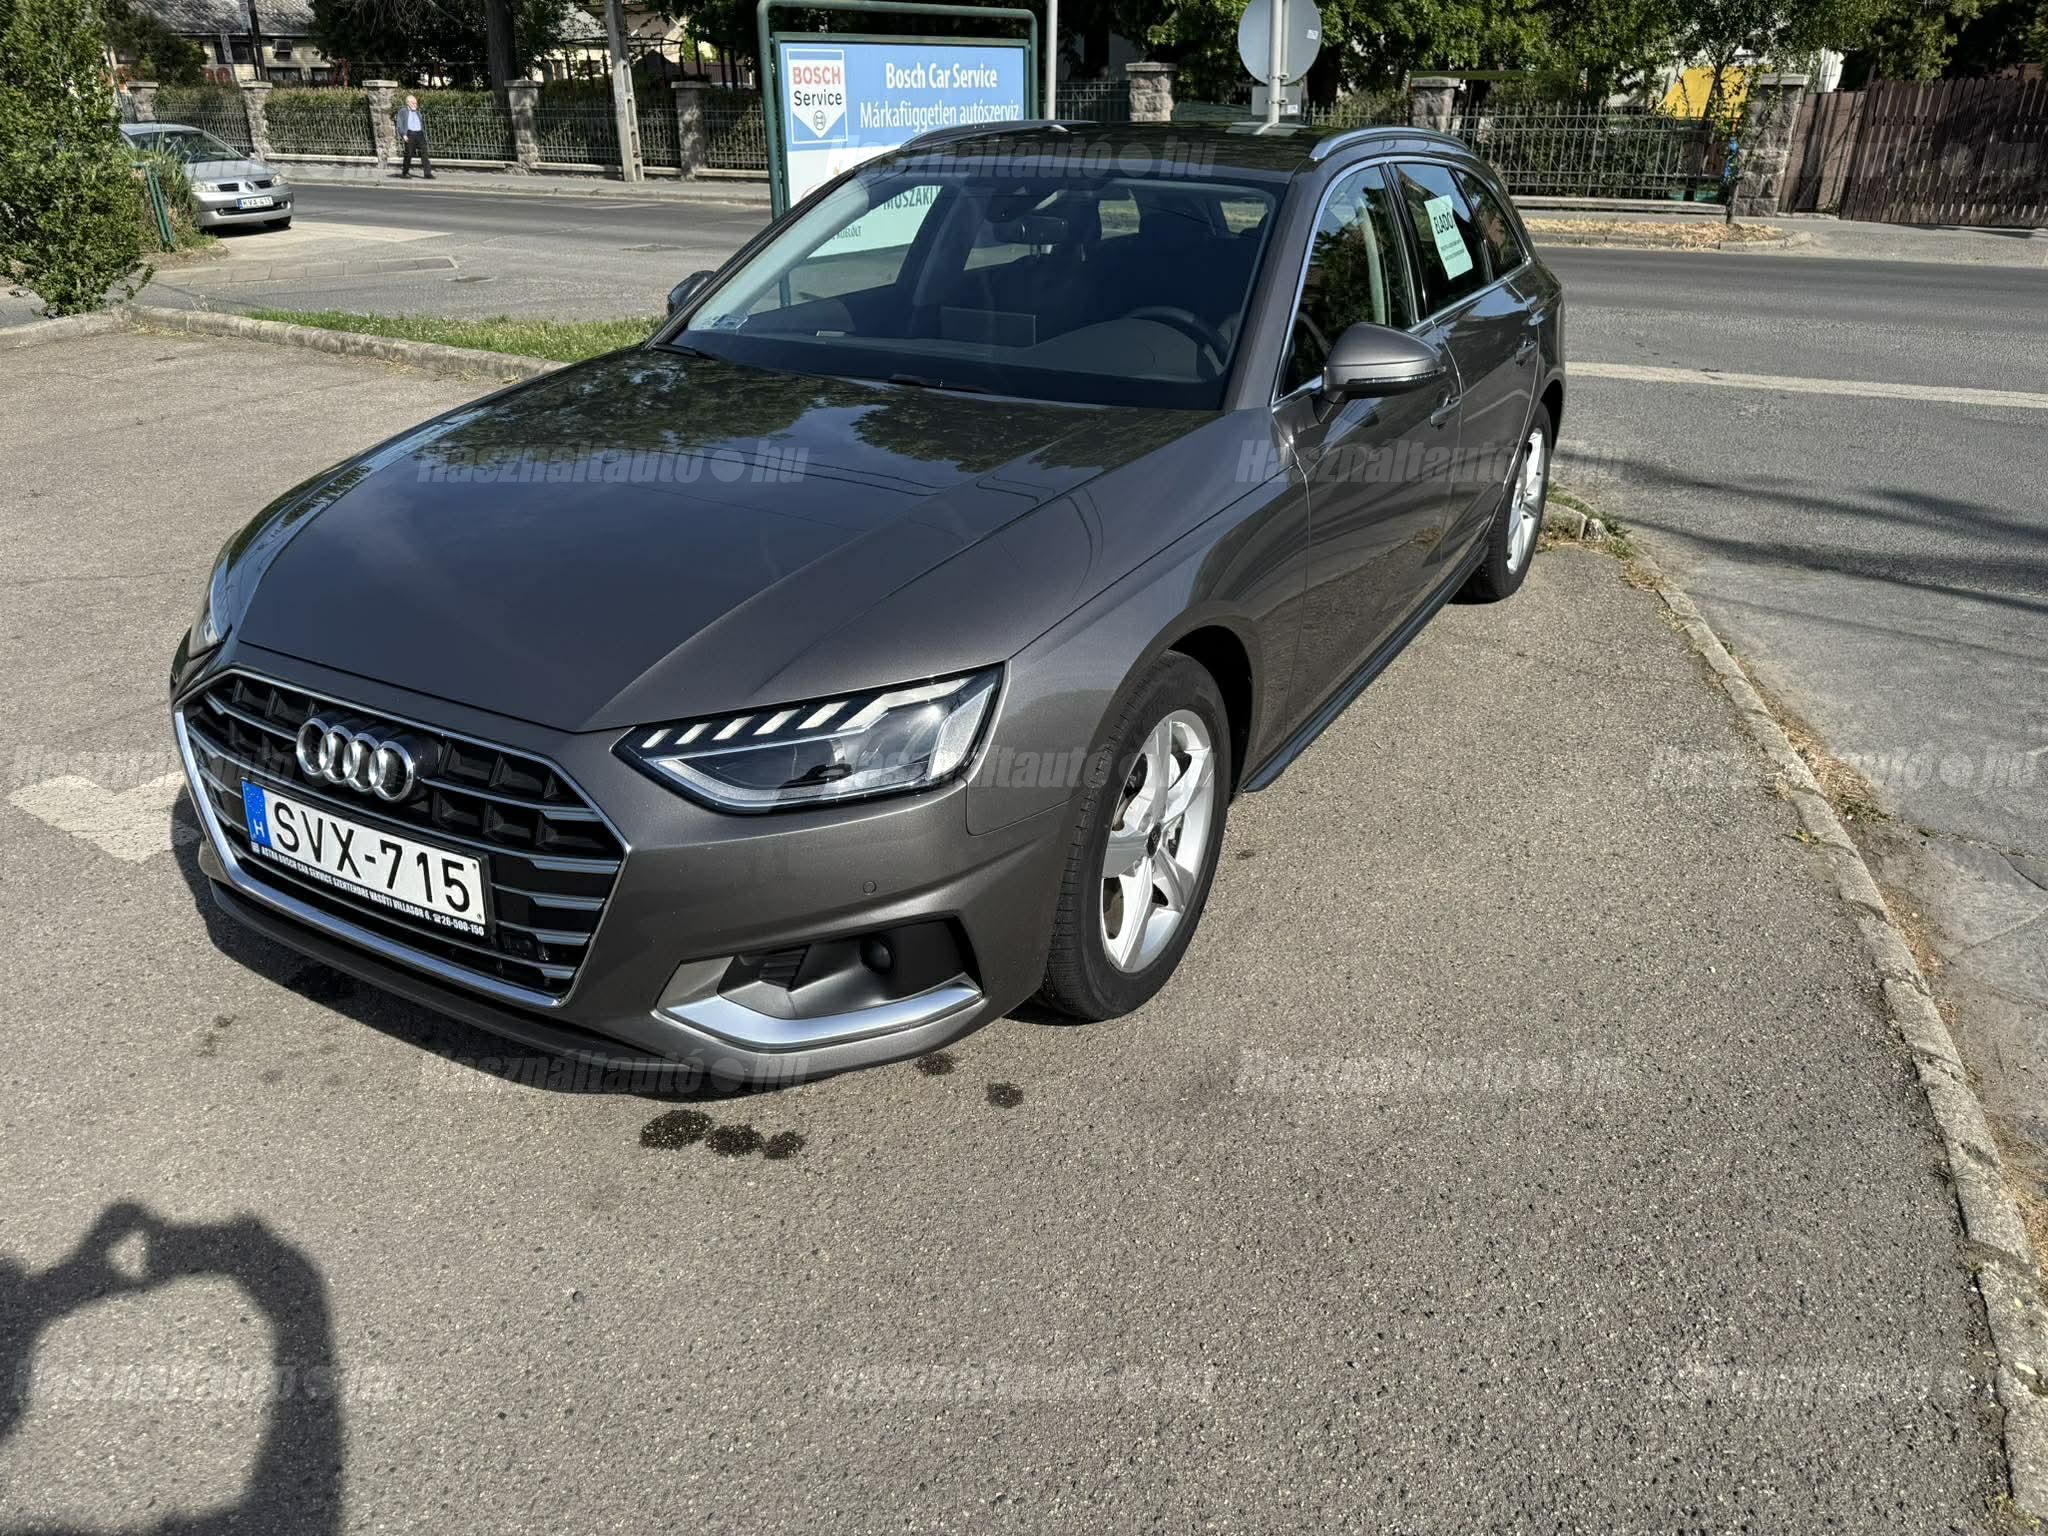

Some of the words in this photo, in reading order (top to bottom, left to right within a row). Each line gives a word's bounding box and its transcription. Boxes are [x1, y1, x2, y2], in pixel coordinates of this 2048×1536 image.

[792, 66, 841, 86] BOSCH
[886, 62, 925, 89] Bosch
[928, 64, 951, 88] Car
[953, 63, 998, 88] Service
[793, 91, 843, 107] Service
[860, 101, 957, 133] Márkafüggetlen
[960, 99, 1020, 126] autószerviz
[253, 819, 265, 837] H
[274, 801, 470, 912] SVX-715
[297, 861, 310, 875] CAR
[309, 867, 333, 885] SERVICE
